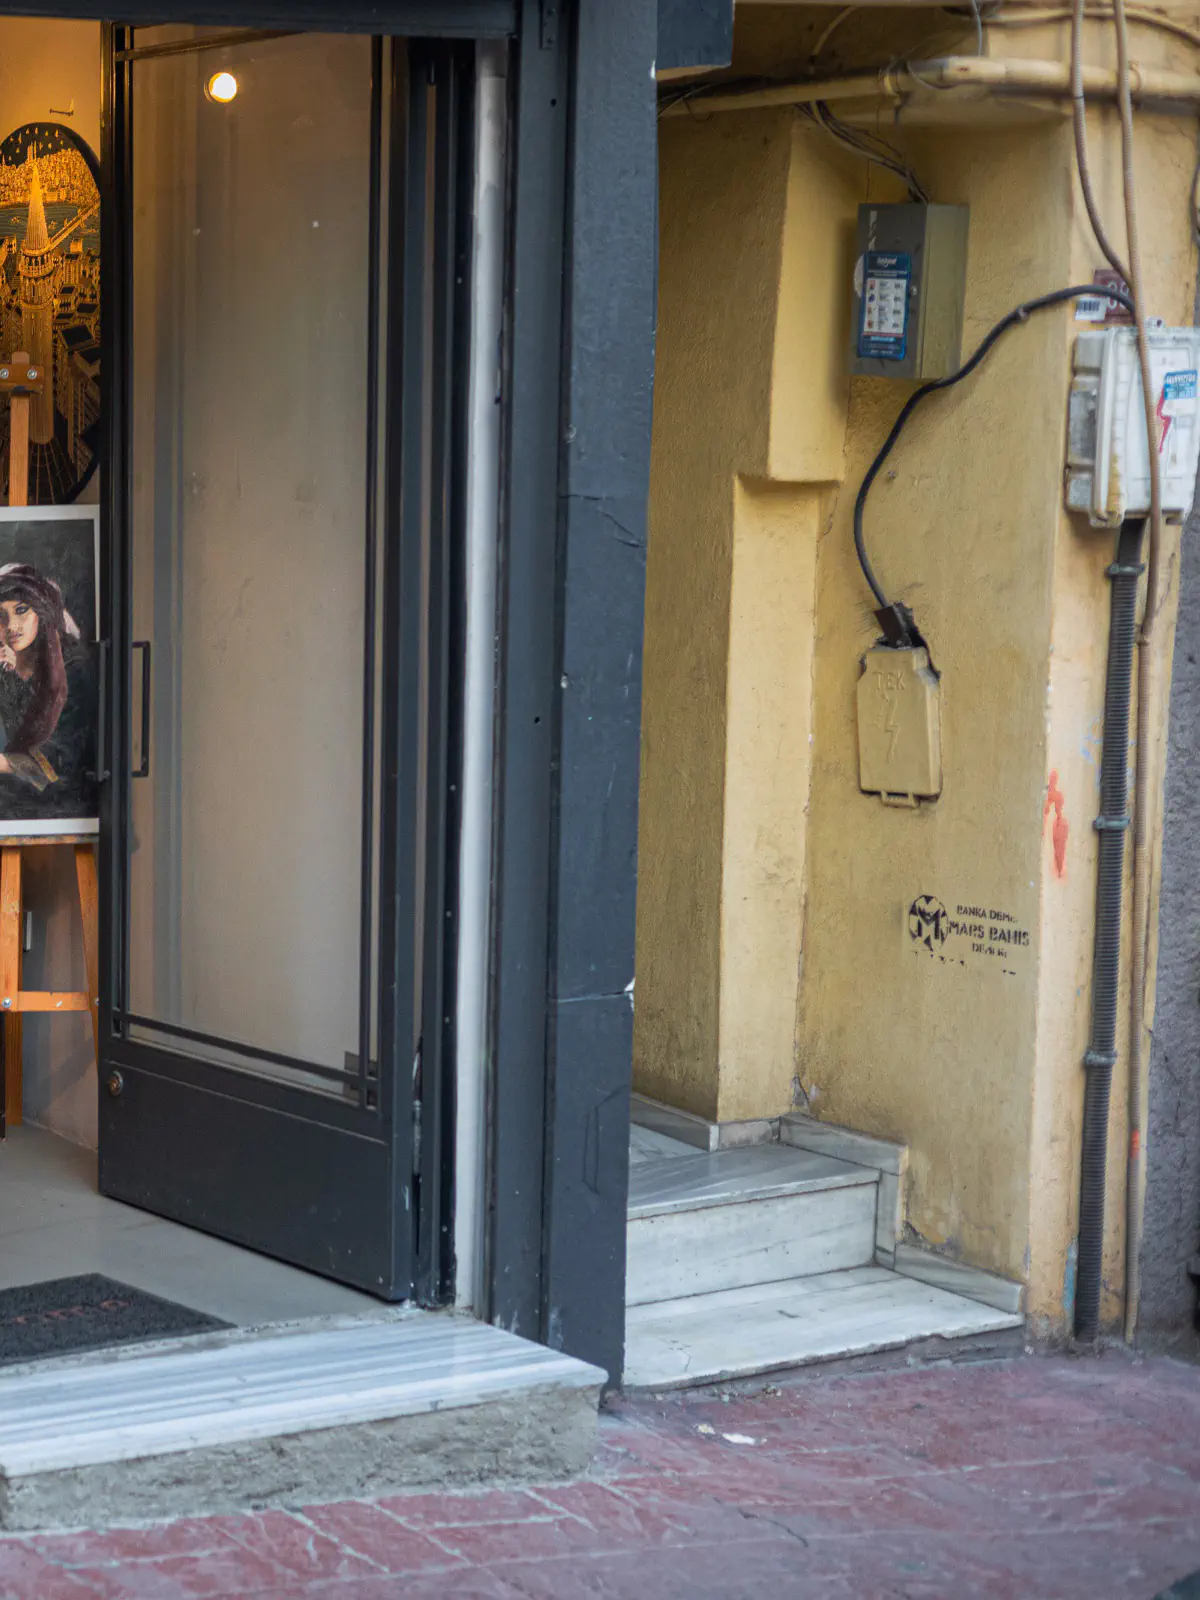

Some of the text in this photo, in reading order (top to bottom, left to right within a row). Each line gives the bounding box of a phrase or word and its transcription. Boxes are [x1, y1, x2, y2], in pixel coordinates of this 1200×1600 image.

[872, 670, 905, 690] TEK
[957, 906, 987, 919] BANKA
[949, 920, 984, 939] MARS
